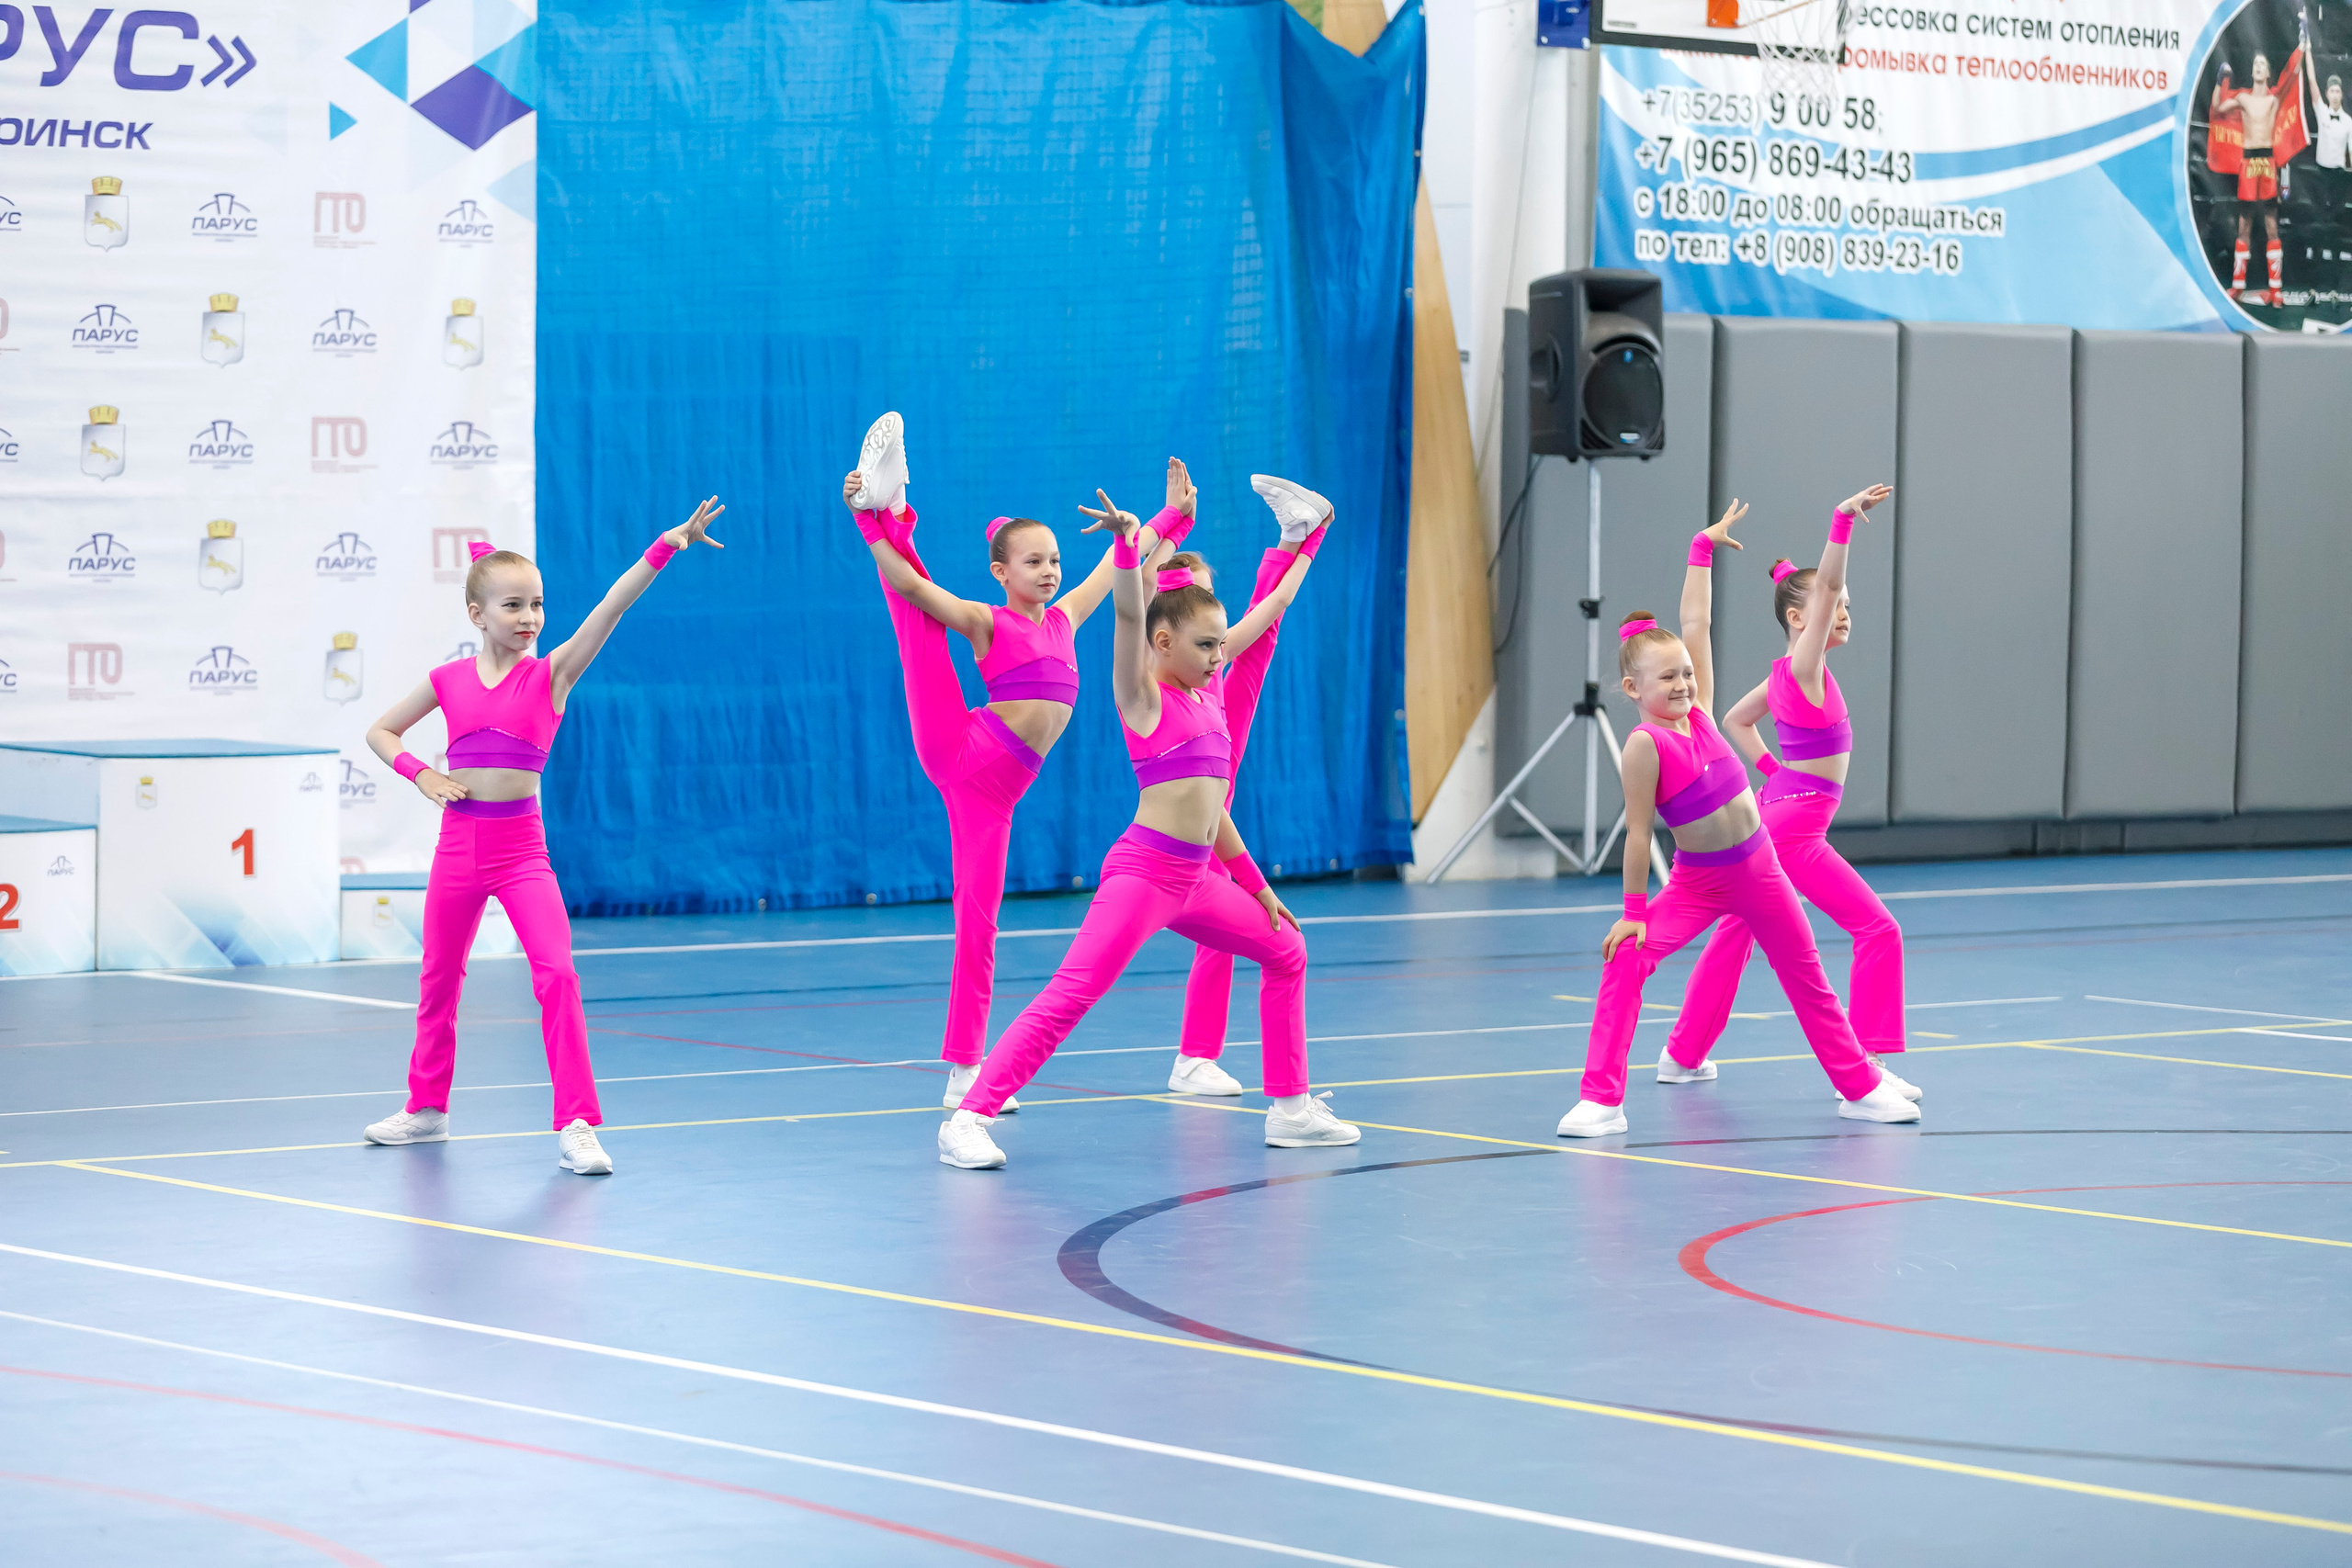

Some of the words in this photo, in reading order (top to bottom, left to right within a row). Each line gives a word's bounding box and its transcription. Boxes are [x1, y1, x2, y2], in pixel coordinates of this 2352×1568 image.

[1849, 6, 1957, 33] ессовка
[1966, 14, 2052, 40] систем
[2061, 21, 2179, 50] отопления
[1956, 55, 2167, 90] теплообменников
[1770, 90, 1784, 124] 9
[1798, 94, 1830, 127] 00
[1639, 136, 1673, 169] +7
[1685, 136, 1757, 183] (965)
[1770, 143, 1911, 184] 869-43-43
[1637, 192, 1650, 212] с
[1661, 186, 1725, 217] 18:00
[1735, 198, 1768, 223] до
[1777, 194, 1841, 223] 08:00
[1851, 197, 2002, 231] обращаться
[192, 217, 257, 231] ПАРУС
[438, 223, 493, 237] ПАРУС
[1637, 234, 1665, 256] по
[1677, 237, 1726, 259] тел:
[1738, 233, 1766, 261] +8
[1777, 233, 1834, 270] (908)
[1844, 239, 1959, 270] 839-23-16
[73, 328, 138, 343] ПАРУС
[312, 333, 377, 346] ПАРУС
[189, 444, 253, 457] ПАРУС
[430, 445, 498, 458] ПАРУС
[69, 557, 135, 570] ПАРУС
[316, 557, 377, 570] ПАРУС
[189, 670, 257, 684] ПАРУС
[232, 829, 255, 876] 1
[0, 883, 20, 930] 2
